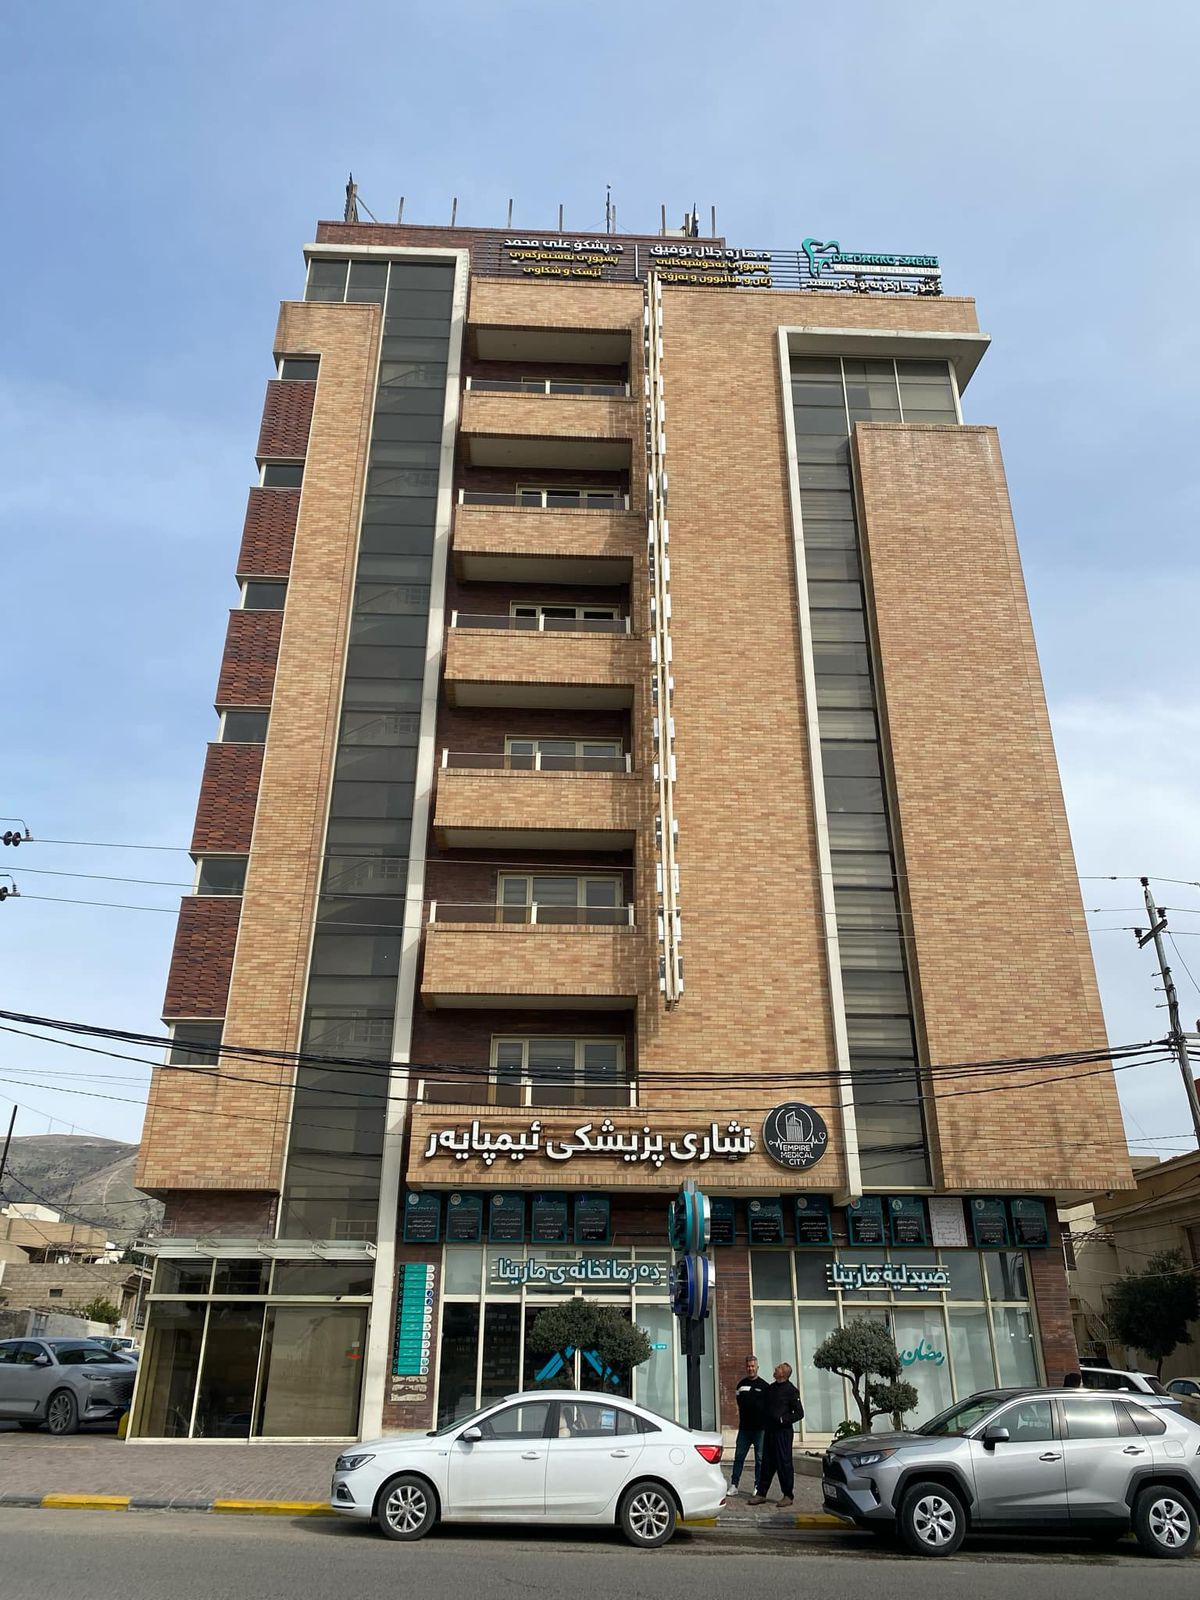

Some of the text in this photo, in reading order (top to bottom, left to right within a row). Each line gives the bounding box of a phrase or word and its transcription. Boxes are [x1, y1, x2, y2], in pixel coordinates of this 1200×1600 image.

[504, 238, 539, 247] محمد
[573, 239, 610, 253] پشکۆ
[563, 267, 570, 276] و
[425, 1119, 751, 1167] شاری پزیشکی ئیمپایەر
[882, 1263, 947, 1290] صيدلية
[899, 1338, 945, 1366] رمضان
